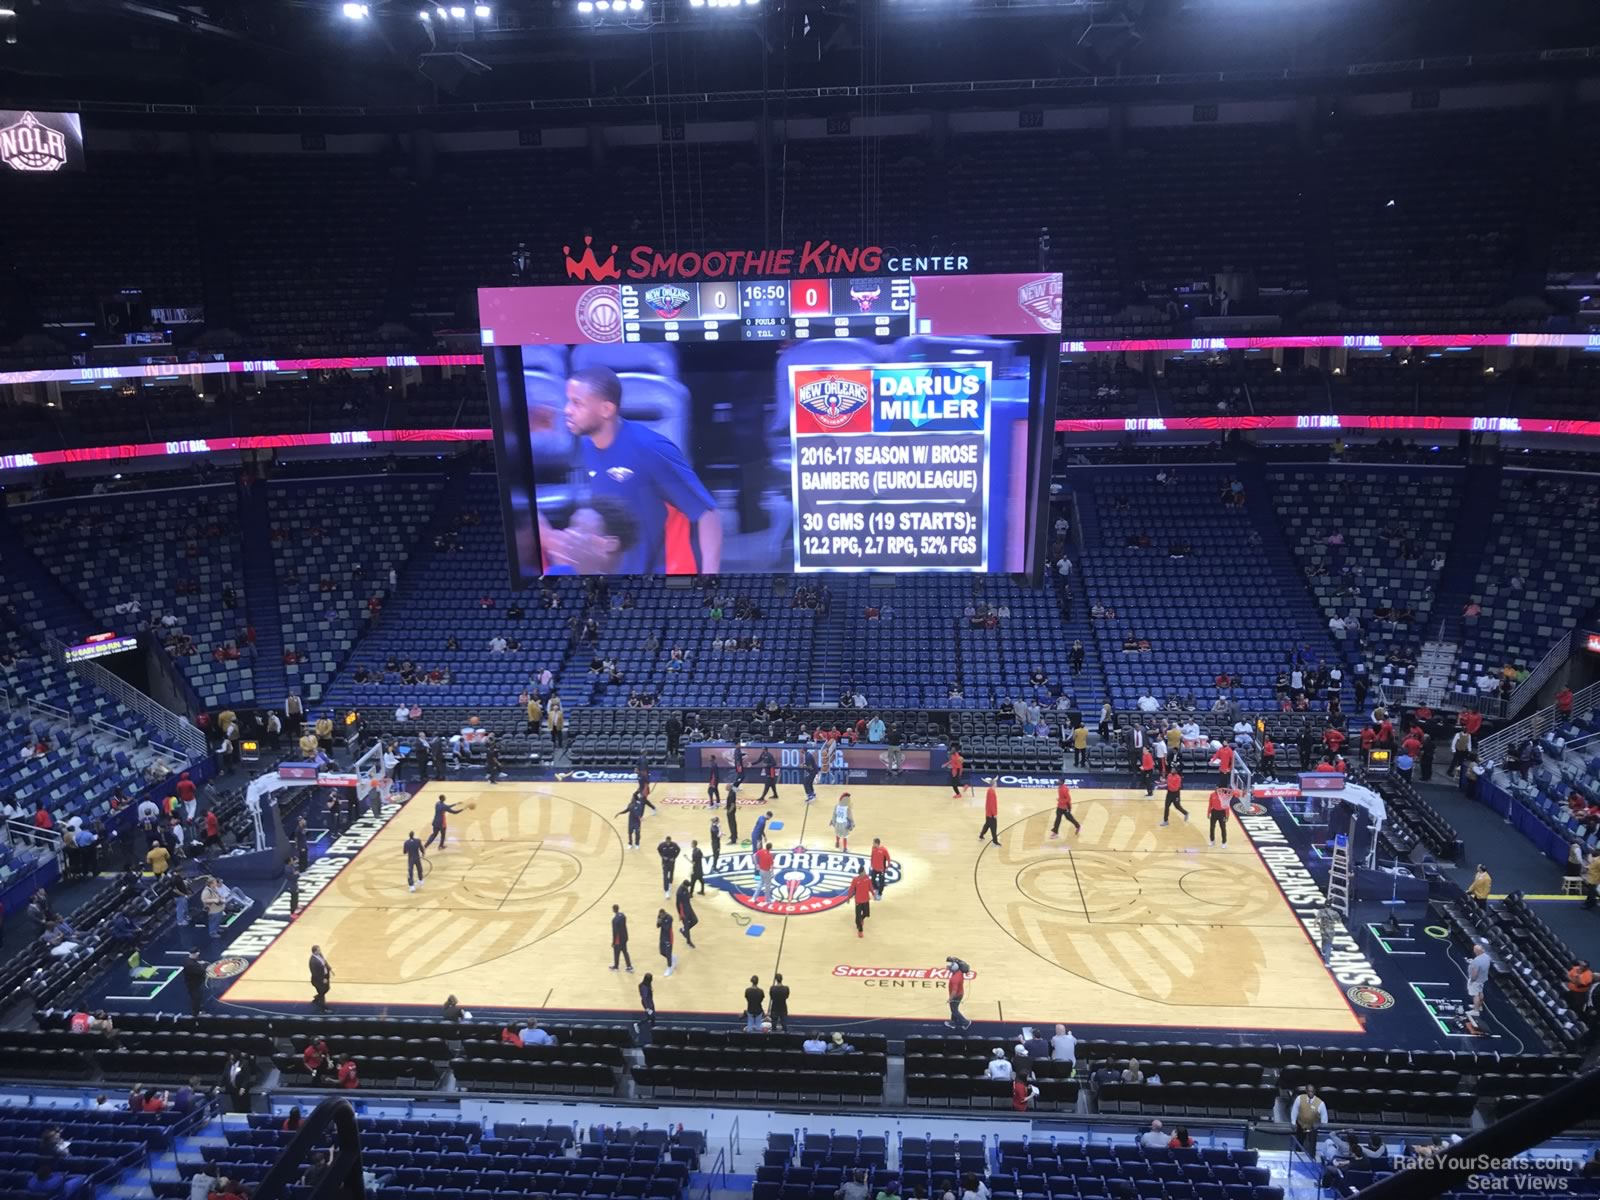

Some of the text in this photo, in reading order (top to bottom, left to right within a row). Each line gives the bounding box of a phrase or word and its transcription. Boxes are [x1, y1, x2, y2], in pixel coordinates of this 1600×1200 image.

[1, 128, 63, 158] NOLA
[626, 246, 795, 279] SMOOTHIE
[888, 256, 969, 272] CENTER
[714, 290, 727, 309] 0
[745, 285, 785, 300] 16:50
[806, 288, 818, 306] 0
[891, 279, 910, 311] CHI
[622, 285, 640, 320] NOP
[755, 318, 776, 326] FOULS
[1191, 338, 1202, 349] DO
[1344, 336, 1355, 346] DO
[243, 361, 254, 372] DO
[386, 356, 397, 367] DO
[81, 368, 93, 379] DO
[800, 382, 868, 402] NEW ORLEANS
[880, 375, 980, 396] DARIUS
[881, 400, 979, 419] MILLER
[1124, 418, 1137, 431] DO
[1297, 415, 1310, 428] DO
[1472, 417, 1487, 430] DO
[329, 432, 342, 444] DO
[166, 441, 180, 454] DO
[801, 445, 978, 465] 2016-17 SEASON W/ BROSE
[802, 470, 978, 494] BAMBERG (EUROLEAGUE)
[803, 512, 976, 534] 30 GMS (19 STARTS):
[803, 536, 977, 557] 12.2 PPG, 2.7 RPG, 52% FGS
[782, 749, 799, 767] DO
[572, 770, 640, 779] Ochsne
[1239, 815, 1289, 844] NEW
[773, 853, 902, 881] ORLEAS
[1258, 846, 1327, 905] ORLEANS
[748, 898, 832, 911] ELICANS
[221, 918, 290, 957] NEW
[834, 965, 927, 977] SMOOTHIE
[864, 979, 946, 989] CENTER
